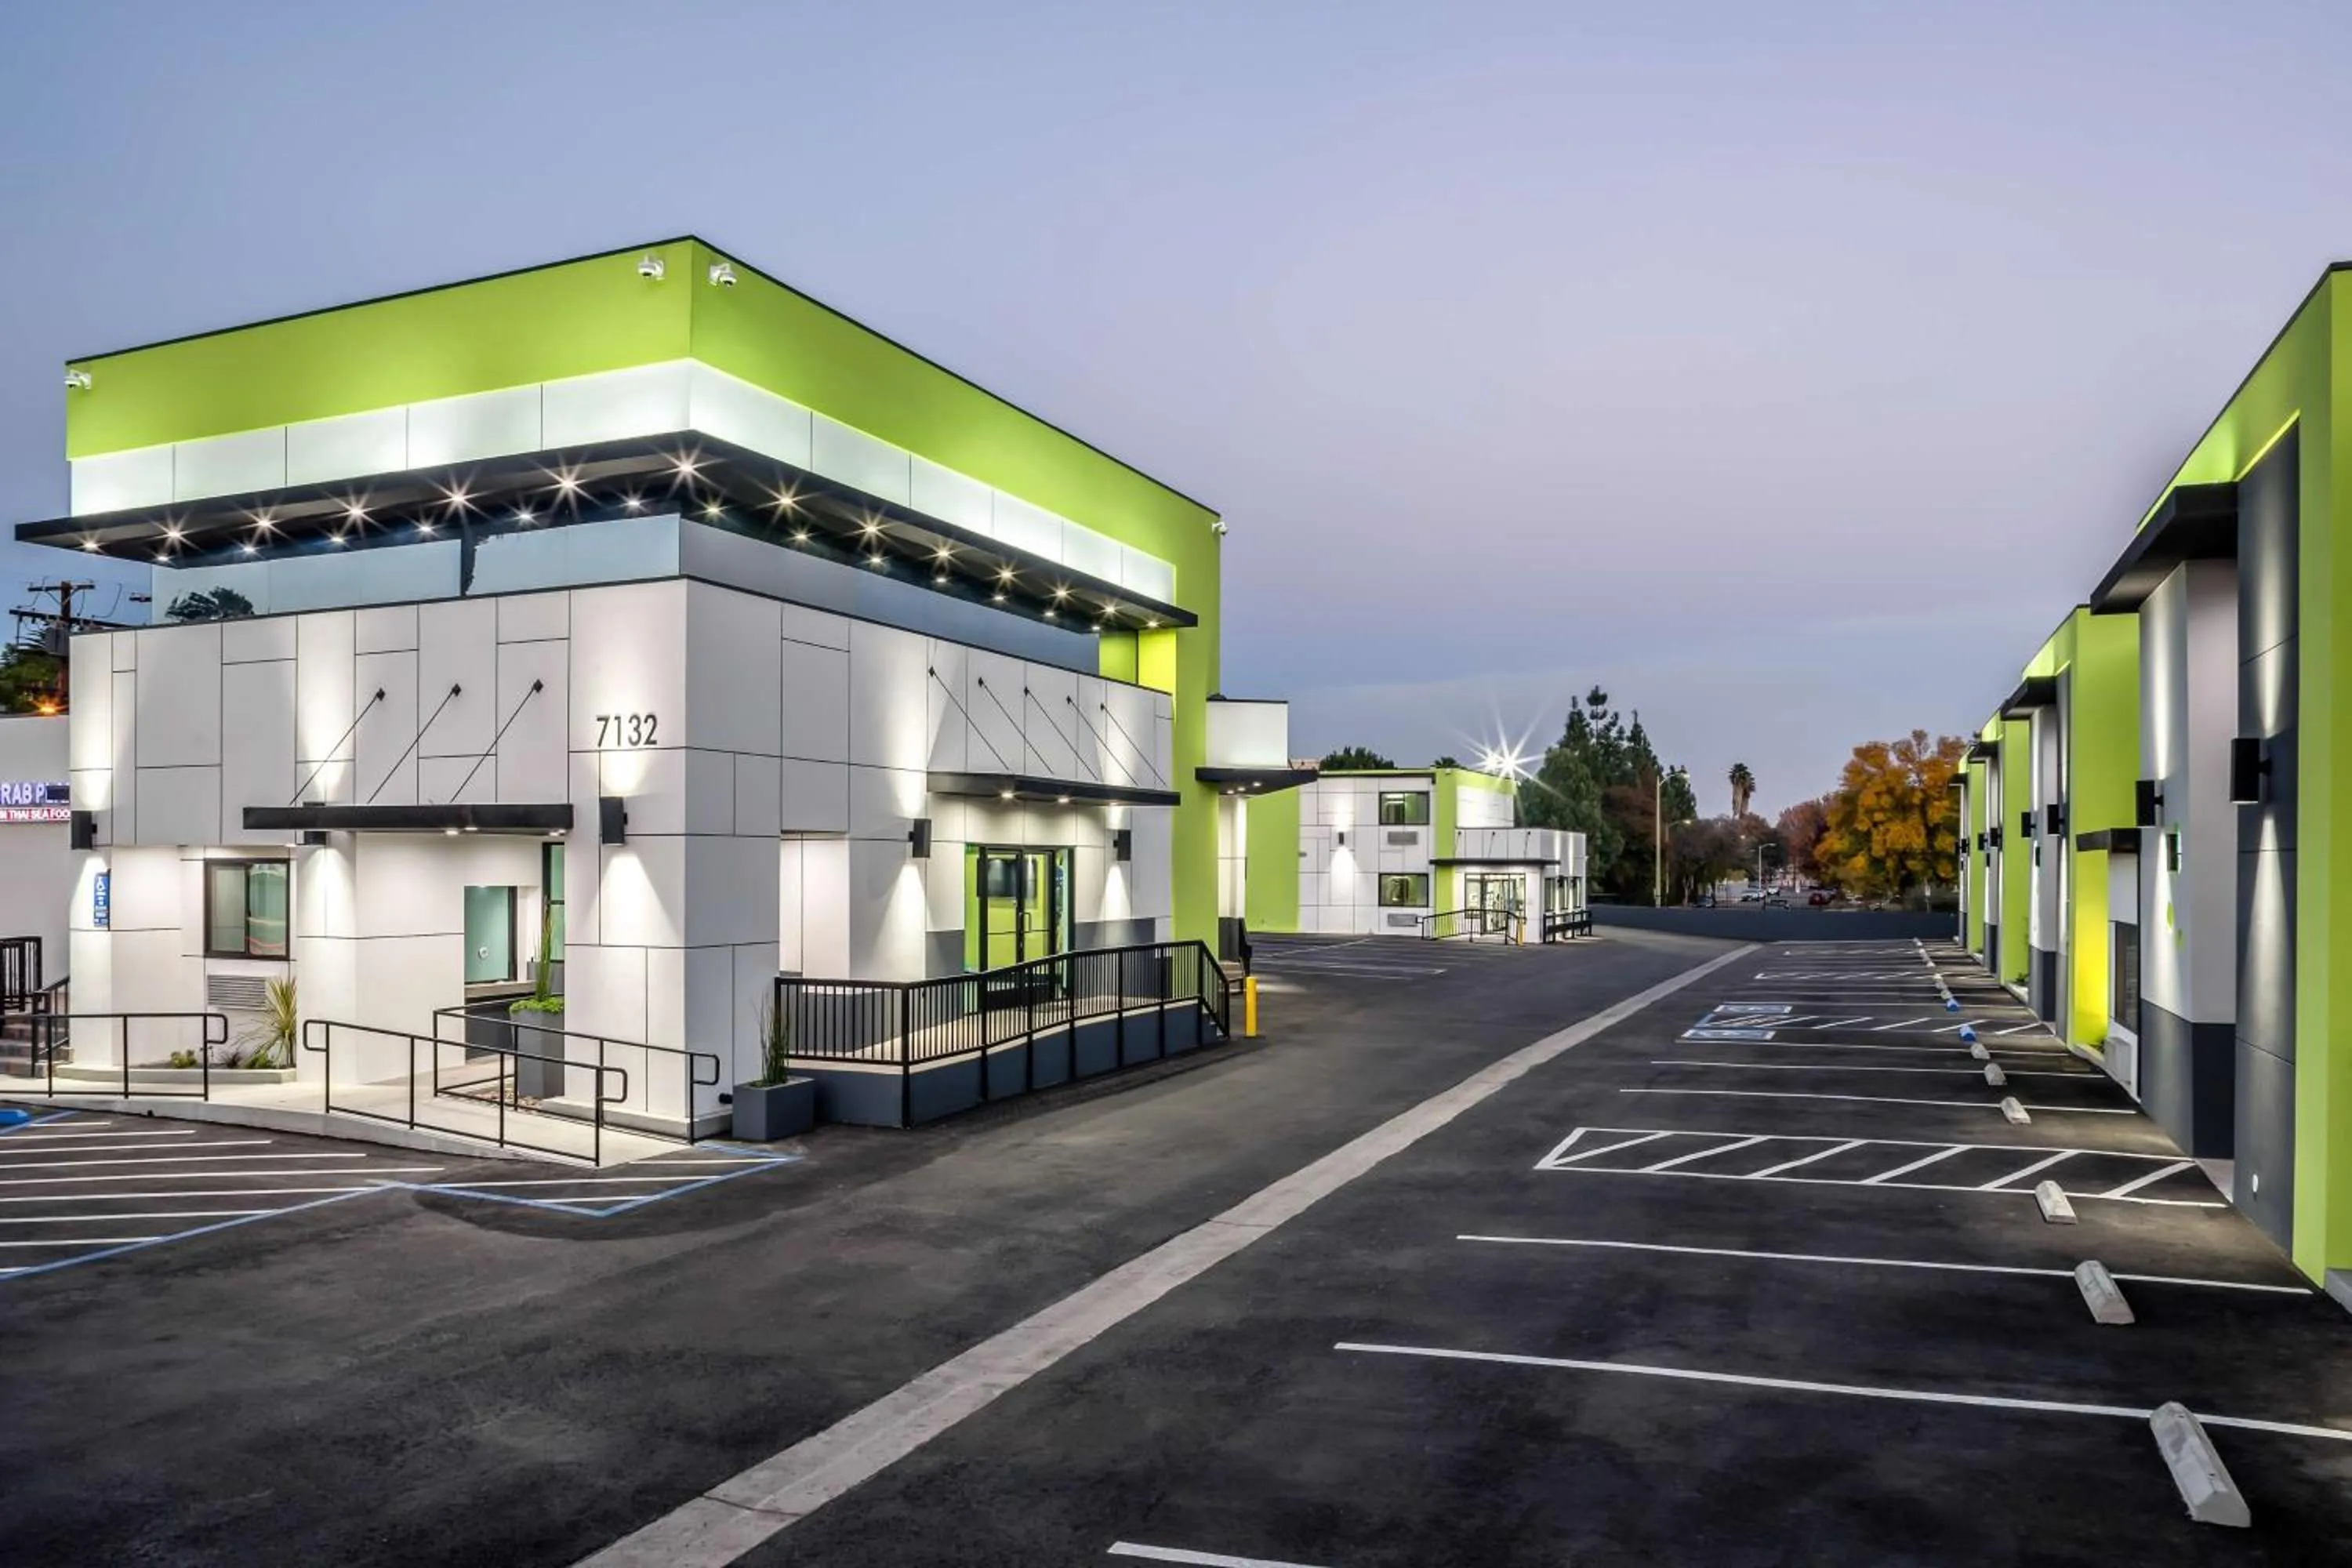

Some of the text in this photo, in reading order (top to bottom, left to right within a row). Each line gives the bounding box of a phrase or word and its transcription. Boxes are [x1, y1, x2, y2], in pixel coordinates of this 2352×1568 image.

[596, 713, 658, 748] 7132
[0, 783, 32, 804] RAB
[51, 809, 71, 818] FOO
